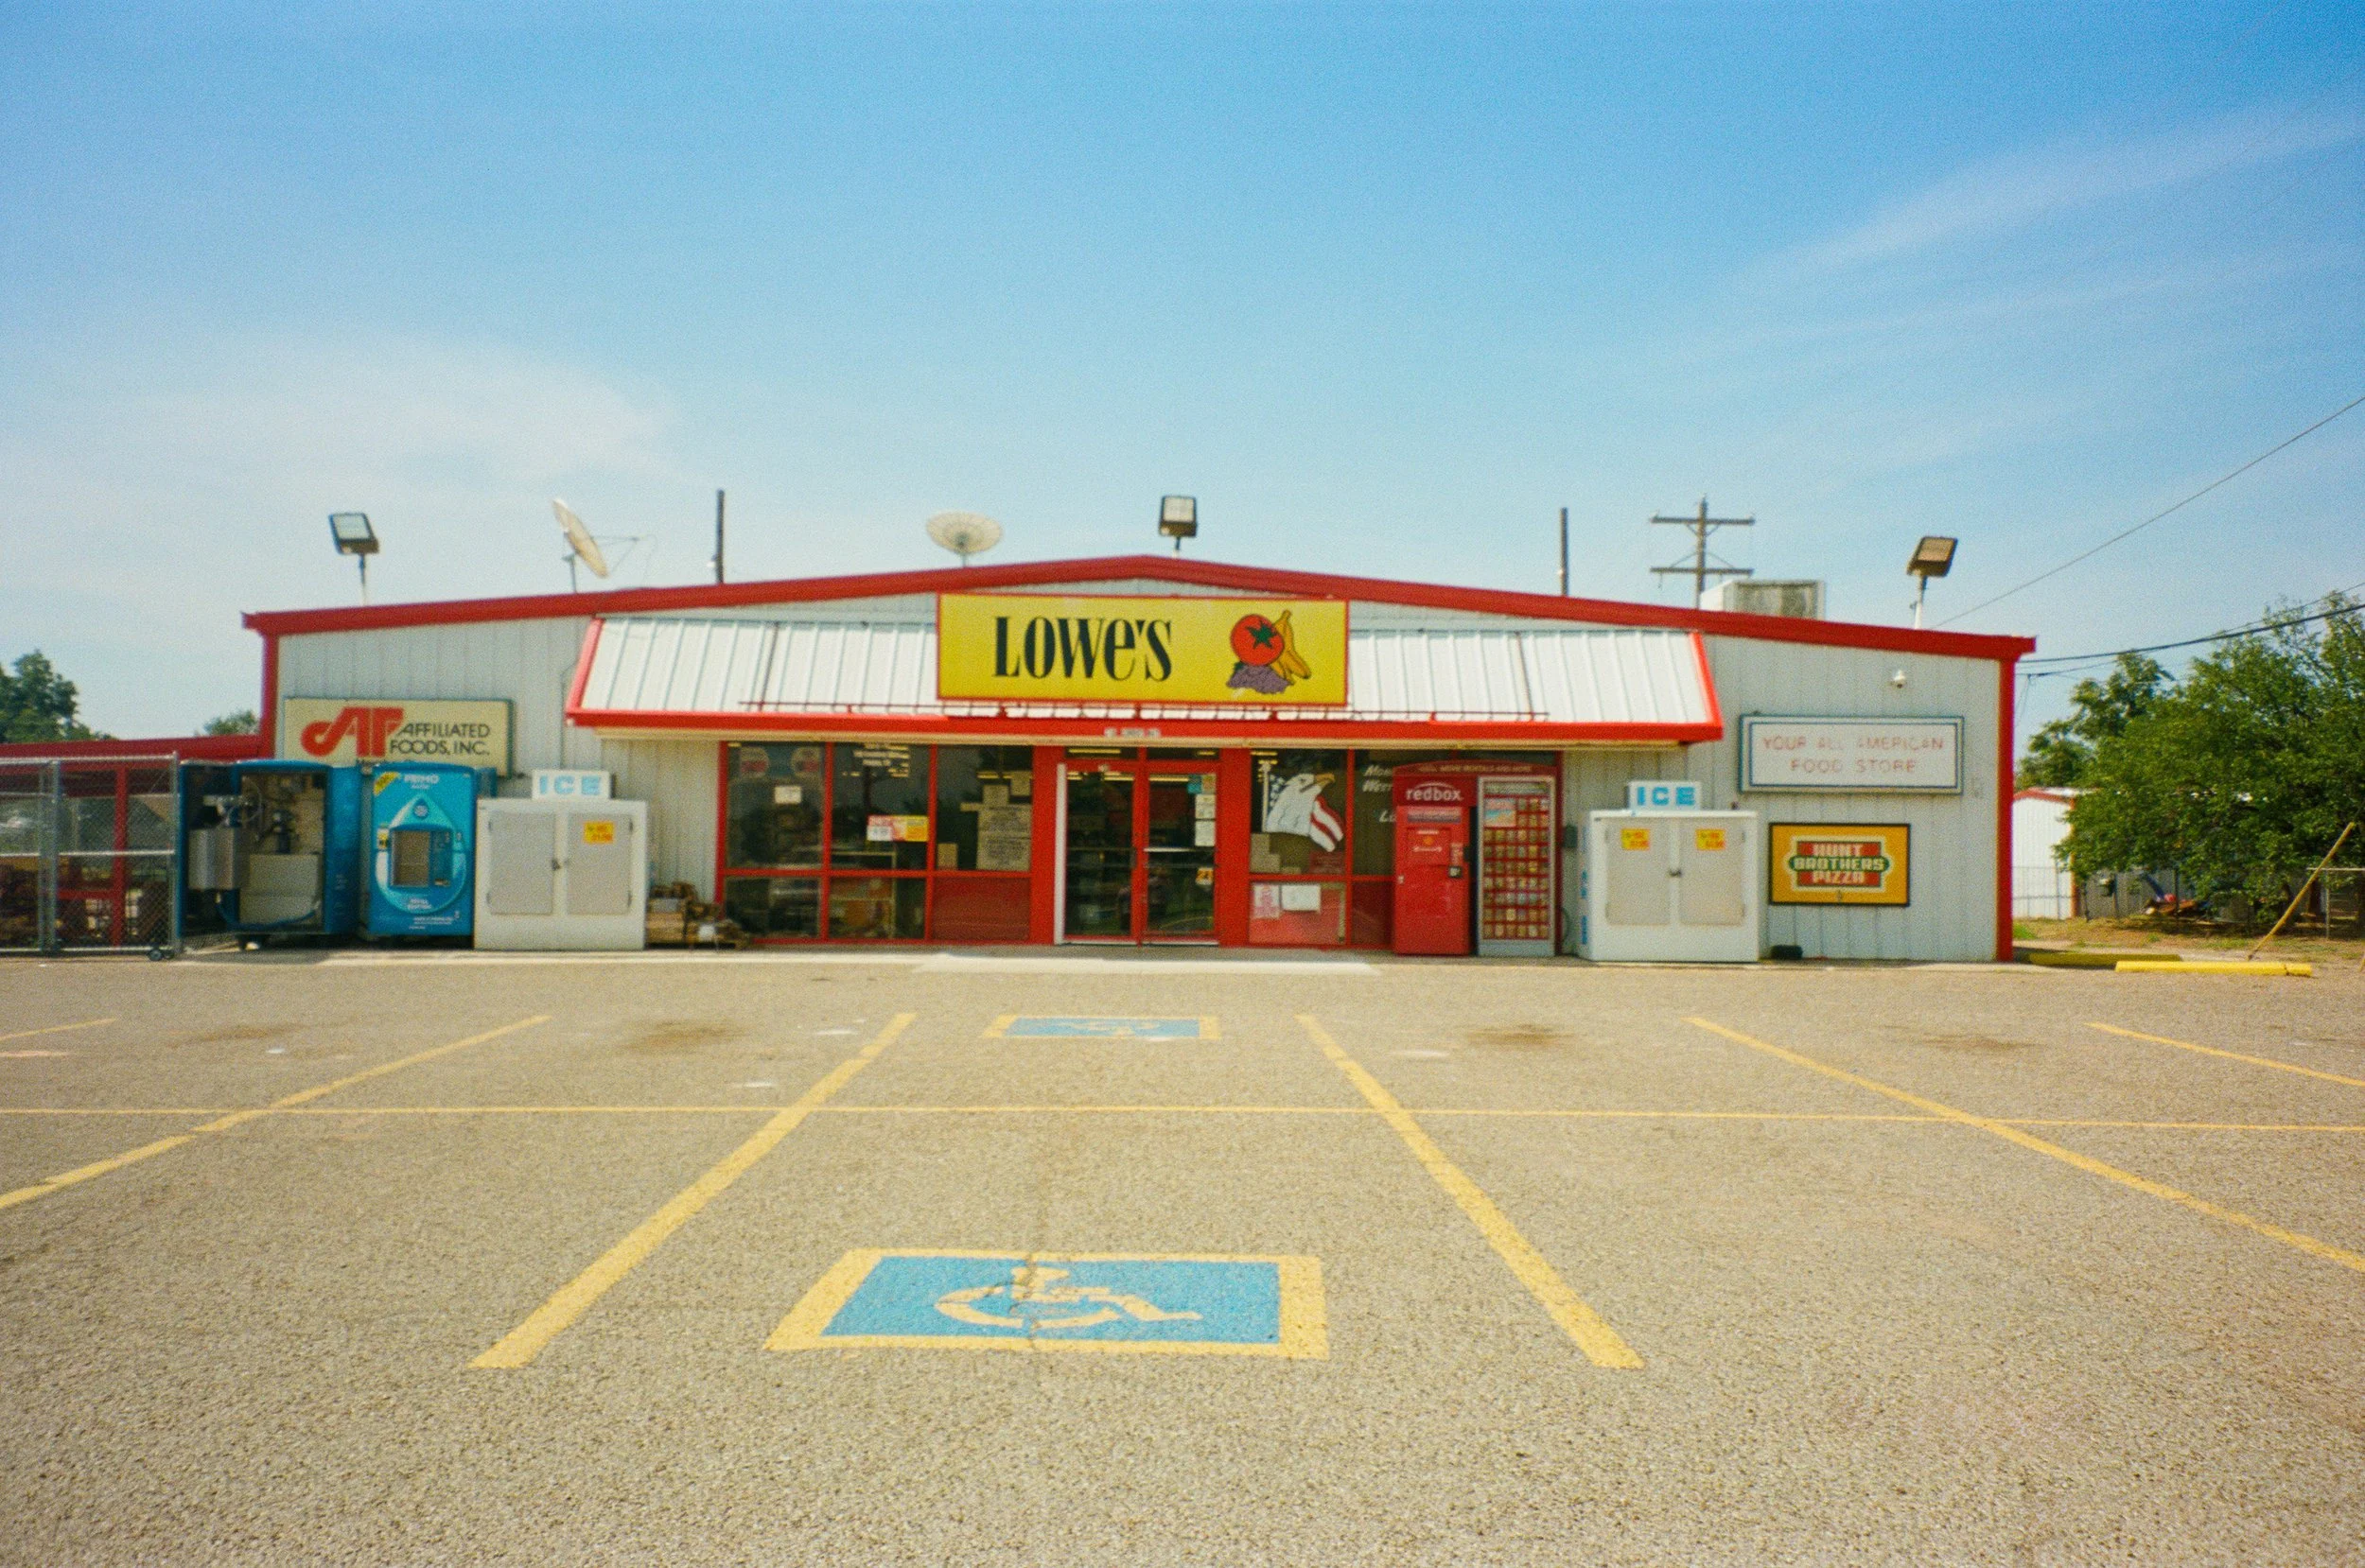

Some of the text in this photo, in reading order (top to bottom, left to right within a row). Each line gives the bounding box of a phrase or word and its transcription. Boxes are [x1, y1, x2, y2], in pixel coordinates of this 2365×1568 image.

[397, 723, 491, 738] AFFILIATED
[390, 740, 490, 756] FOODS, INC.
[539, 775, 600, 794] ICE
[1637, 786, 1695, 806] ICE
[1813, 843, 1863, 857] HUNT
[1793, 857, 1885, 871] BROTHERS
[1812, 871, 1866, 884] PIZZA
